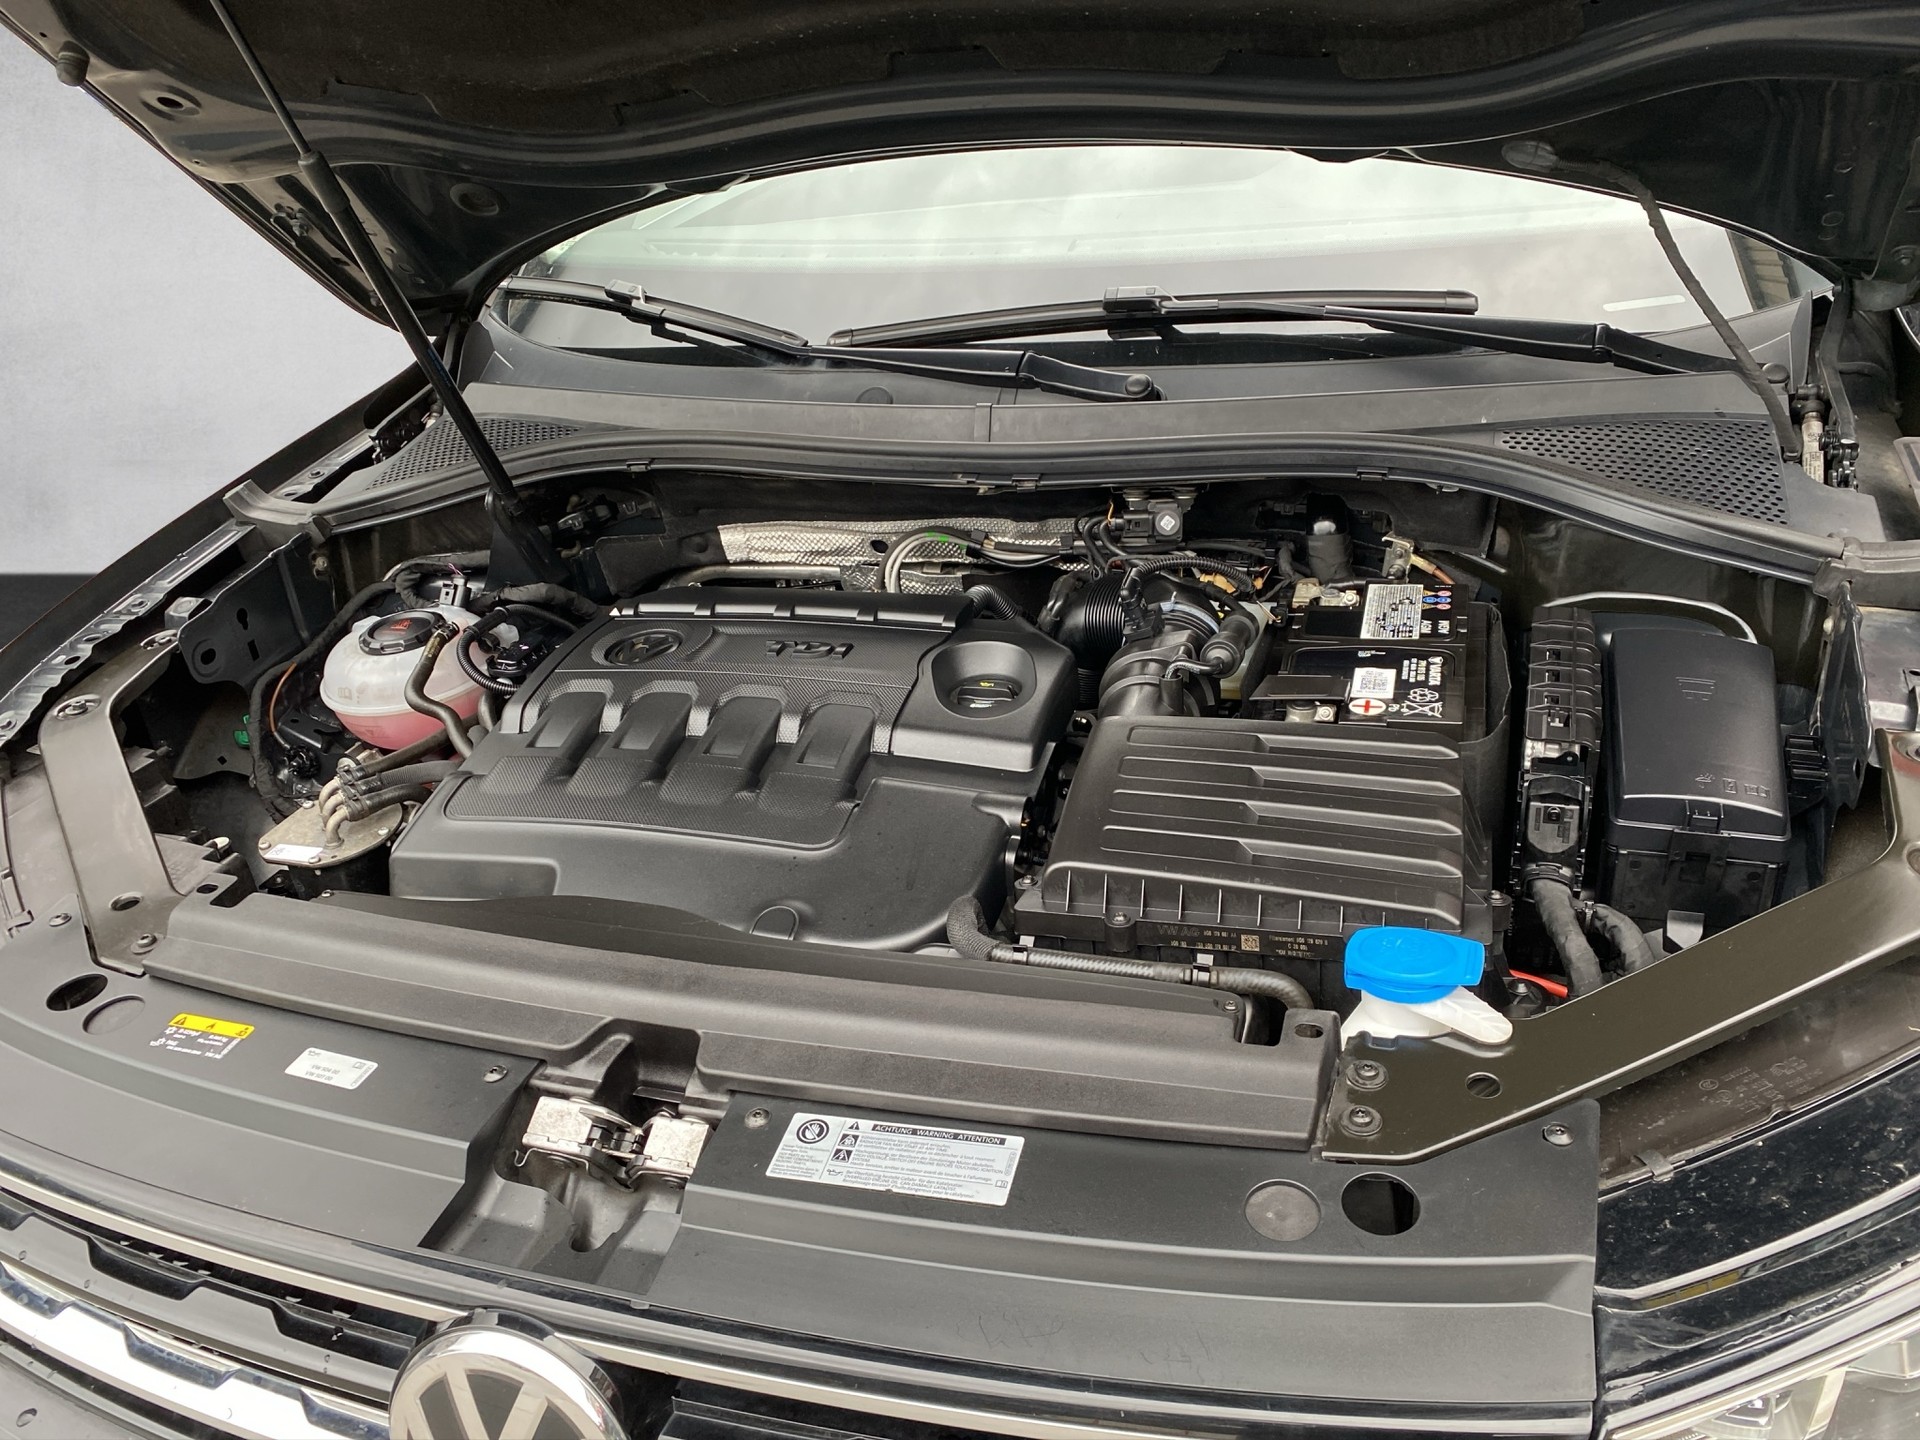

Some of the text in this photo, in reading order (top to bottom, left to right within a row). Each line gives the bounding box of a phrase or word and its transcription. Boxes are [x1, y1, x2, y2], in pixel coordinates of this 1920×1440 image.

[766, 640, 854, 660] TDI
[1428, 664, 1442, 686] VARTA
[1157, 925, 1178, 936] VW
[1180, 926, 1200, 937] AG
[875, 1125, 913, 1134] ACHTUNG
[916, 1130, 954, 1139] WARNING
[957, 1134, 1001, 1144] ATTENTION
